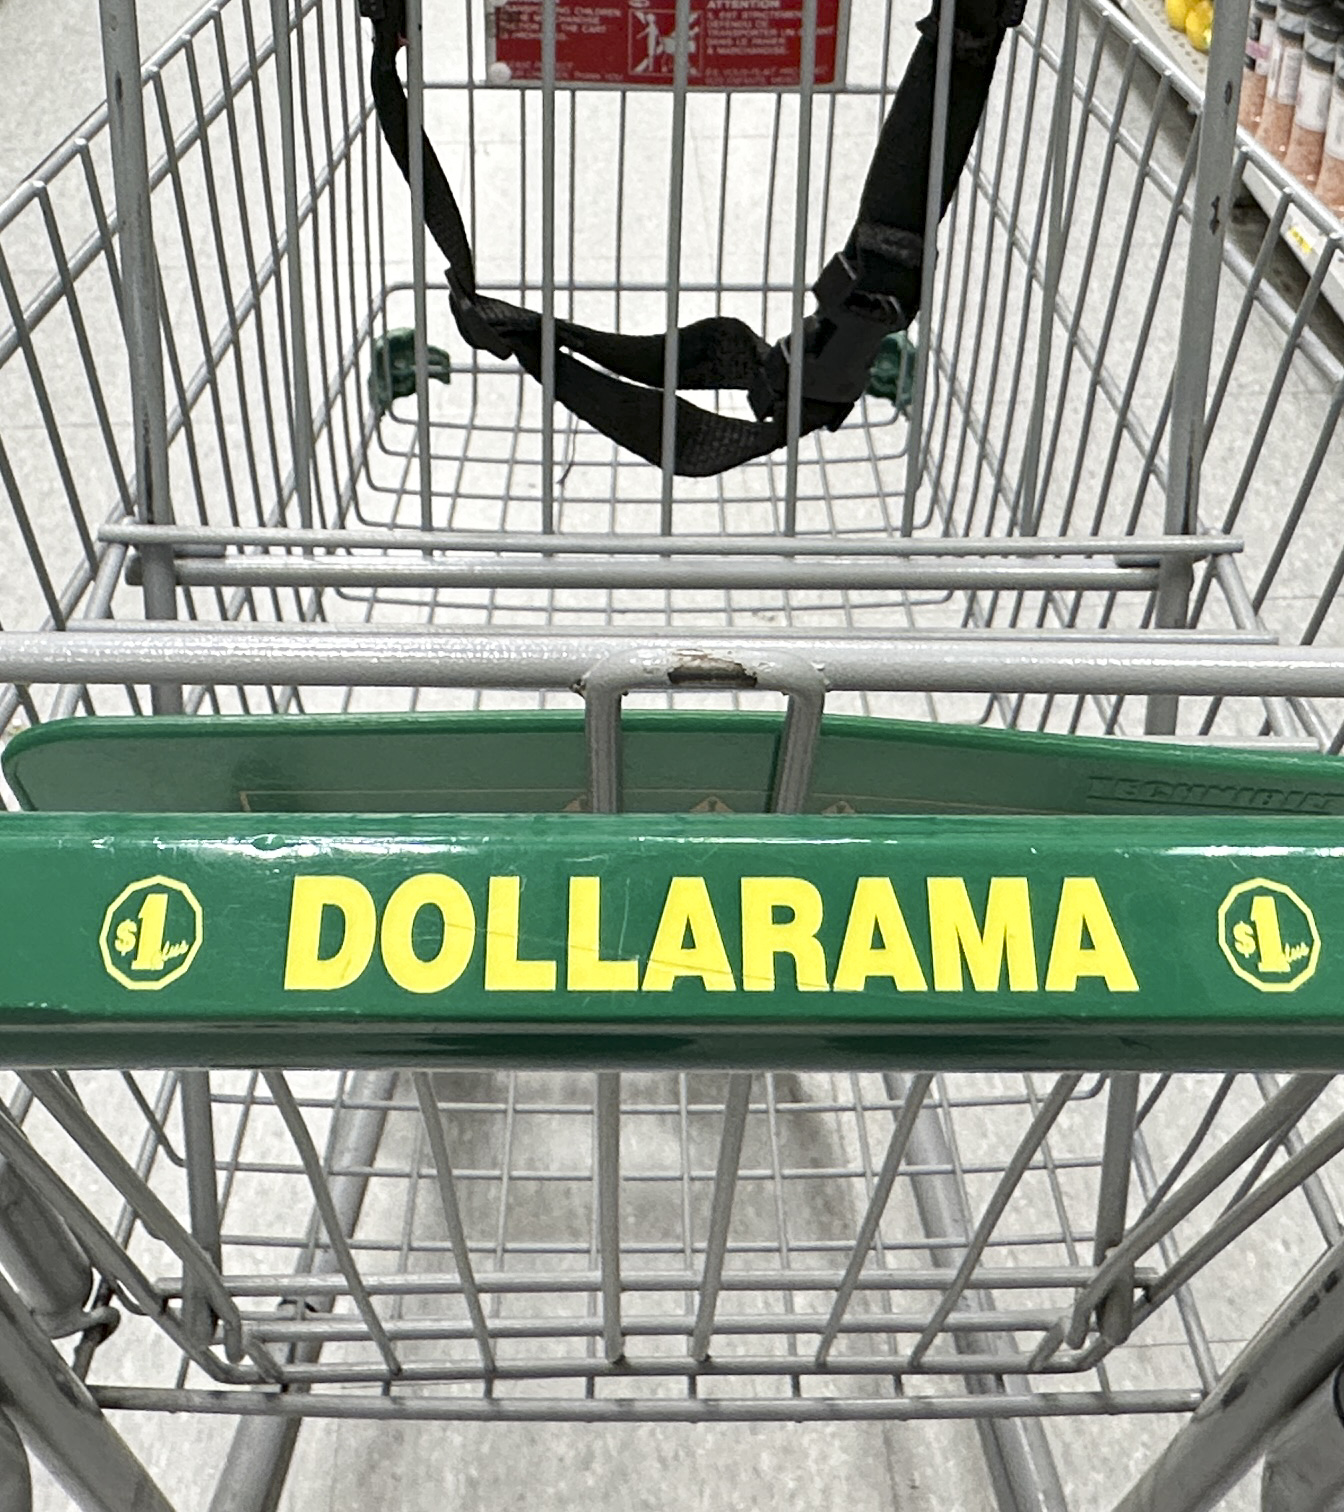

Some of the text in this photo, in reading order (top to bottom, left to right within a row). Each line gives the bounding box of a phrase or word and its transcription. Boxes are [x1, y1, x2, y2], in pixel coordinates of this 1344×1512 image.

[707, 0, 781, 9] ATTENTION
[114, 893, 169, 971] $1
[285, 875, 1140, 992] DOLLARAMA
[1233, 895, 1291, 973] $1
